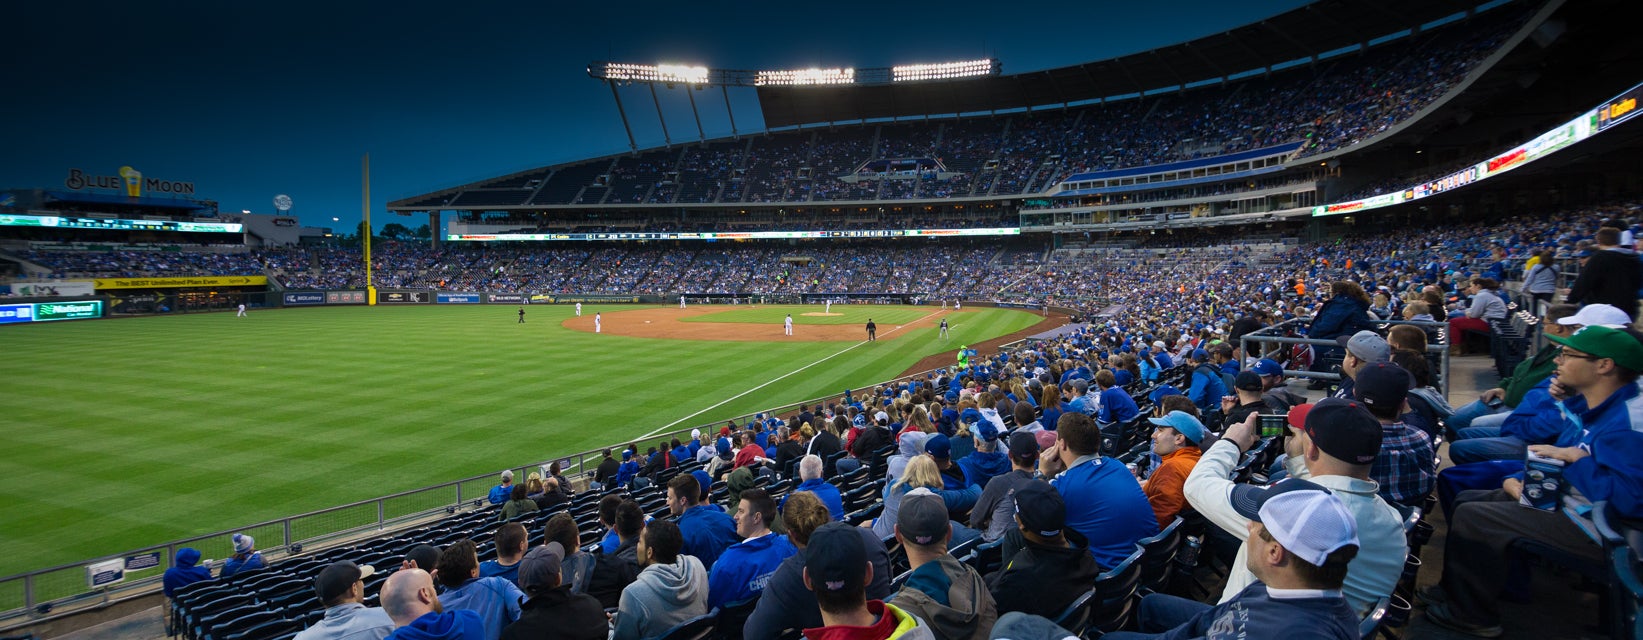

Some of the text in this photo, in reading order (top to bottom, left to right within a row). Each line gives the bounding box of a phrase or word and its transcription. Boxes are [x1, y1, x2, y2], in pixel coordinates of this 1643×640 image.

[67, 169, 194, 193] BLUE MOON
[53, 304, 94, 313] National
